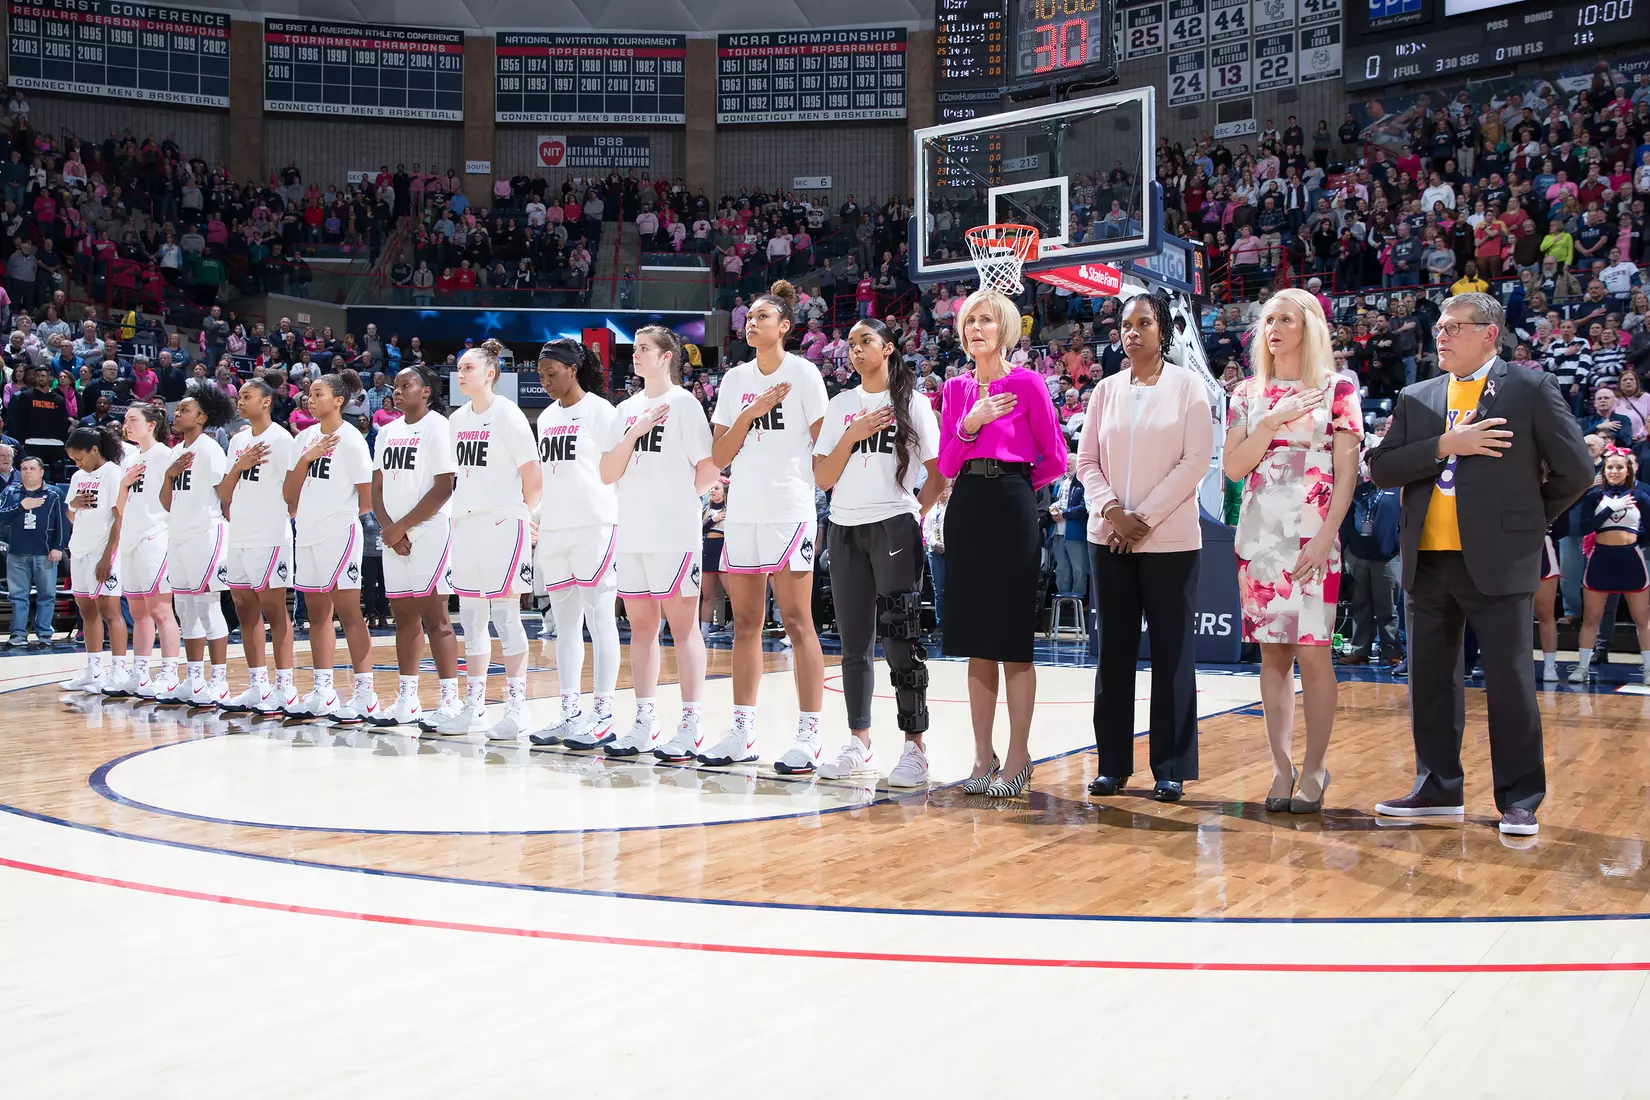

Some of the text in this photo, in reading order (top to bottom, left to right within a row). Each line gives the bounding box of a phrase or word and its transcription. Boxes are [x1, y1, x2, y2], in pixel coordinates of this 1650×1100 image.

[14, 6, 225, 37] REGULAR SEASON CHAMPIONS
[54, 0, 224, 26] EAST CONFERENCE
[1215, 8, 1245, 30] 44
[1394, 13, 1421, 22] Company
[1524, 10, 1553, 24] BONUS
[1577, 0, 1633, 27] 10:00
[286, 24, 307, 32] EAST
[311, 25, 317, 33] &
[320, 26, 362, 35] AMERICAN
[365, 29, 405, 39] ATHLETIC
[407, 32, 459, 42] CONFERENCE
[1173, 17, 1201, 39] 42
[1487, 19, 1509, 31] POSS
[13, 18, 226, 54] 1990 1994 1995 1996 1998 1999 2002
[284, 35, 446, 52] TOURNAMENT CHAMPIONS
[505, 36, 677, 46] NATIONAL INVITATION TOURNAMENT
[730, 31, 895, 45] NCAA CHAMPIONSHIP
[1131, 26, 1159, 49] 25
[12, 39, 102, 61] 2003 2005 2006
[549, 48, 634, 56] APPEARANCES
[728, 44, 897, 56] TOURNAMENT APPEARANCES
[1033, 19, 1087, 73] 30
[1507, 45, 1523, 58] TM
[1524, 41, 1543, 54] FLS
[269, 45, 460, 70] 1990 1996 1998 1999 2002 2004 2011
[500, 59, 682, 73] 1955 1974 1975 1980 1981 1982 1988
[723, 55, 902, 72] 1951 1954 1956 1957 1958 1959 1960
[1444, 57, 1458, 69] 30
[1460, 53, 1480, 66] SEC
[1618, 59, 1649, 73] Harry
[269, 65, 289, 79] 2016
[1260, 56, 1288, 80] 22
[1365, 55, 1380, 79] 0
[1399, 63, 1420, 77] FULL
[722, 74, 902, 91] 1963 1964 1965 1967 1976 1979 1990
[1173, 72, 1201, 95] 24
[1219, 65, 1241, 87] 13
[16, 78, 224, 105] CONNECTICUT MEN'S BASKETBALL
[500, 78, 655, 92] 1989 1993 1997 2001 2010 2015
[723, 93, 902, 110] 1991 1992 1994 1995 1996 1998 1999
[270, 102, 457, 119] CONNECTICUT MEN'S BASKETBALL
[723, 110, 900, 122] CONNECTICUT MEN'S BASKETBALL
[1235, 121, 1255, 133] 214
[593, 137, 623, 146] 1988
[543, 148, 561, 157] NIT
[567, 147, 650, 156] NATIONAL INVITATION
[567, 158, 650, 166] TOURNAMENT CHAMPION
[1020, 157, 1037, 168] 213
[821, 178, 827, 186] 6
[746, 402, 785, 430] NE
[457, 430, 490, 440] POWER OF
[543, 425, 580, 436] POWER OF
[631, 426, 665, 452] NE
[386, 437, 420, 446] POWER OF
[850, 425, 897, 454] NE
[456, 441, 488, 466] ONE
[540, 435, 577, 463] ONE
[382, 447, 417, 470] ONE
[308, 457, 331, 479] NE
[172, 470, 192, 491] NE
